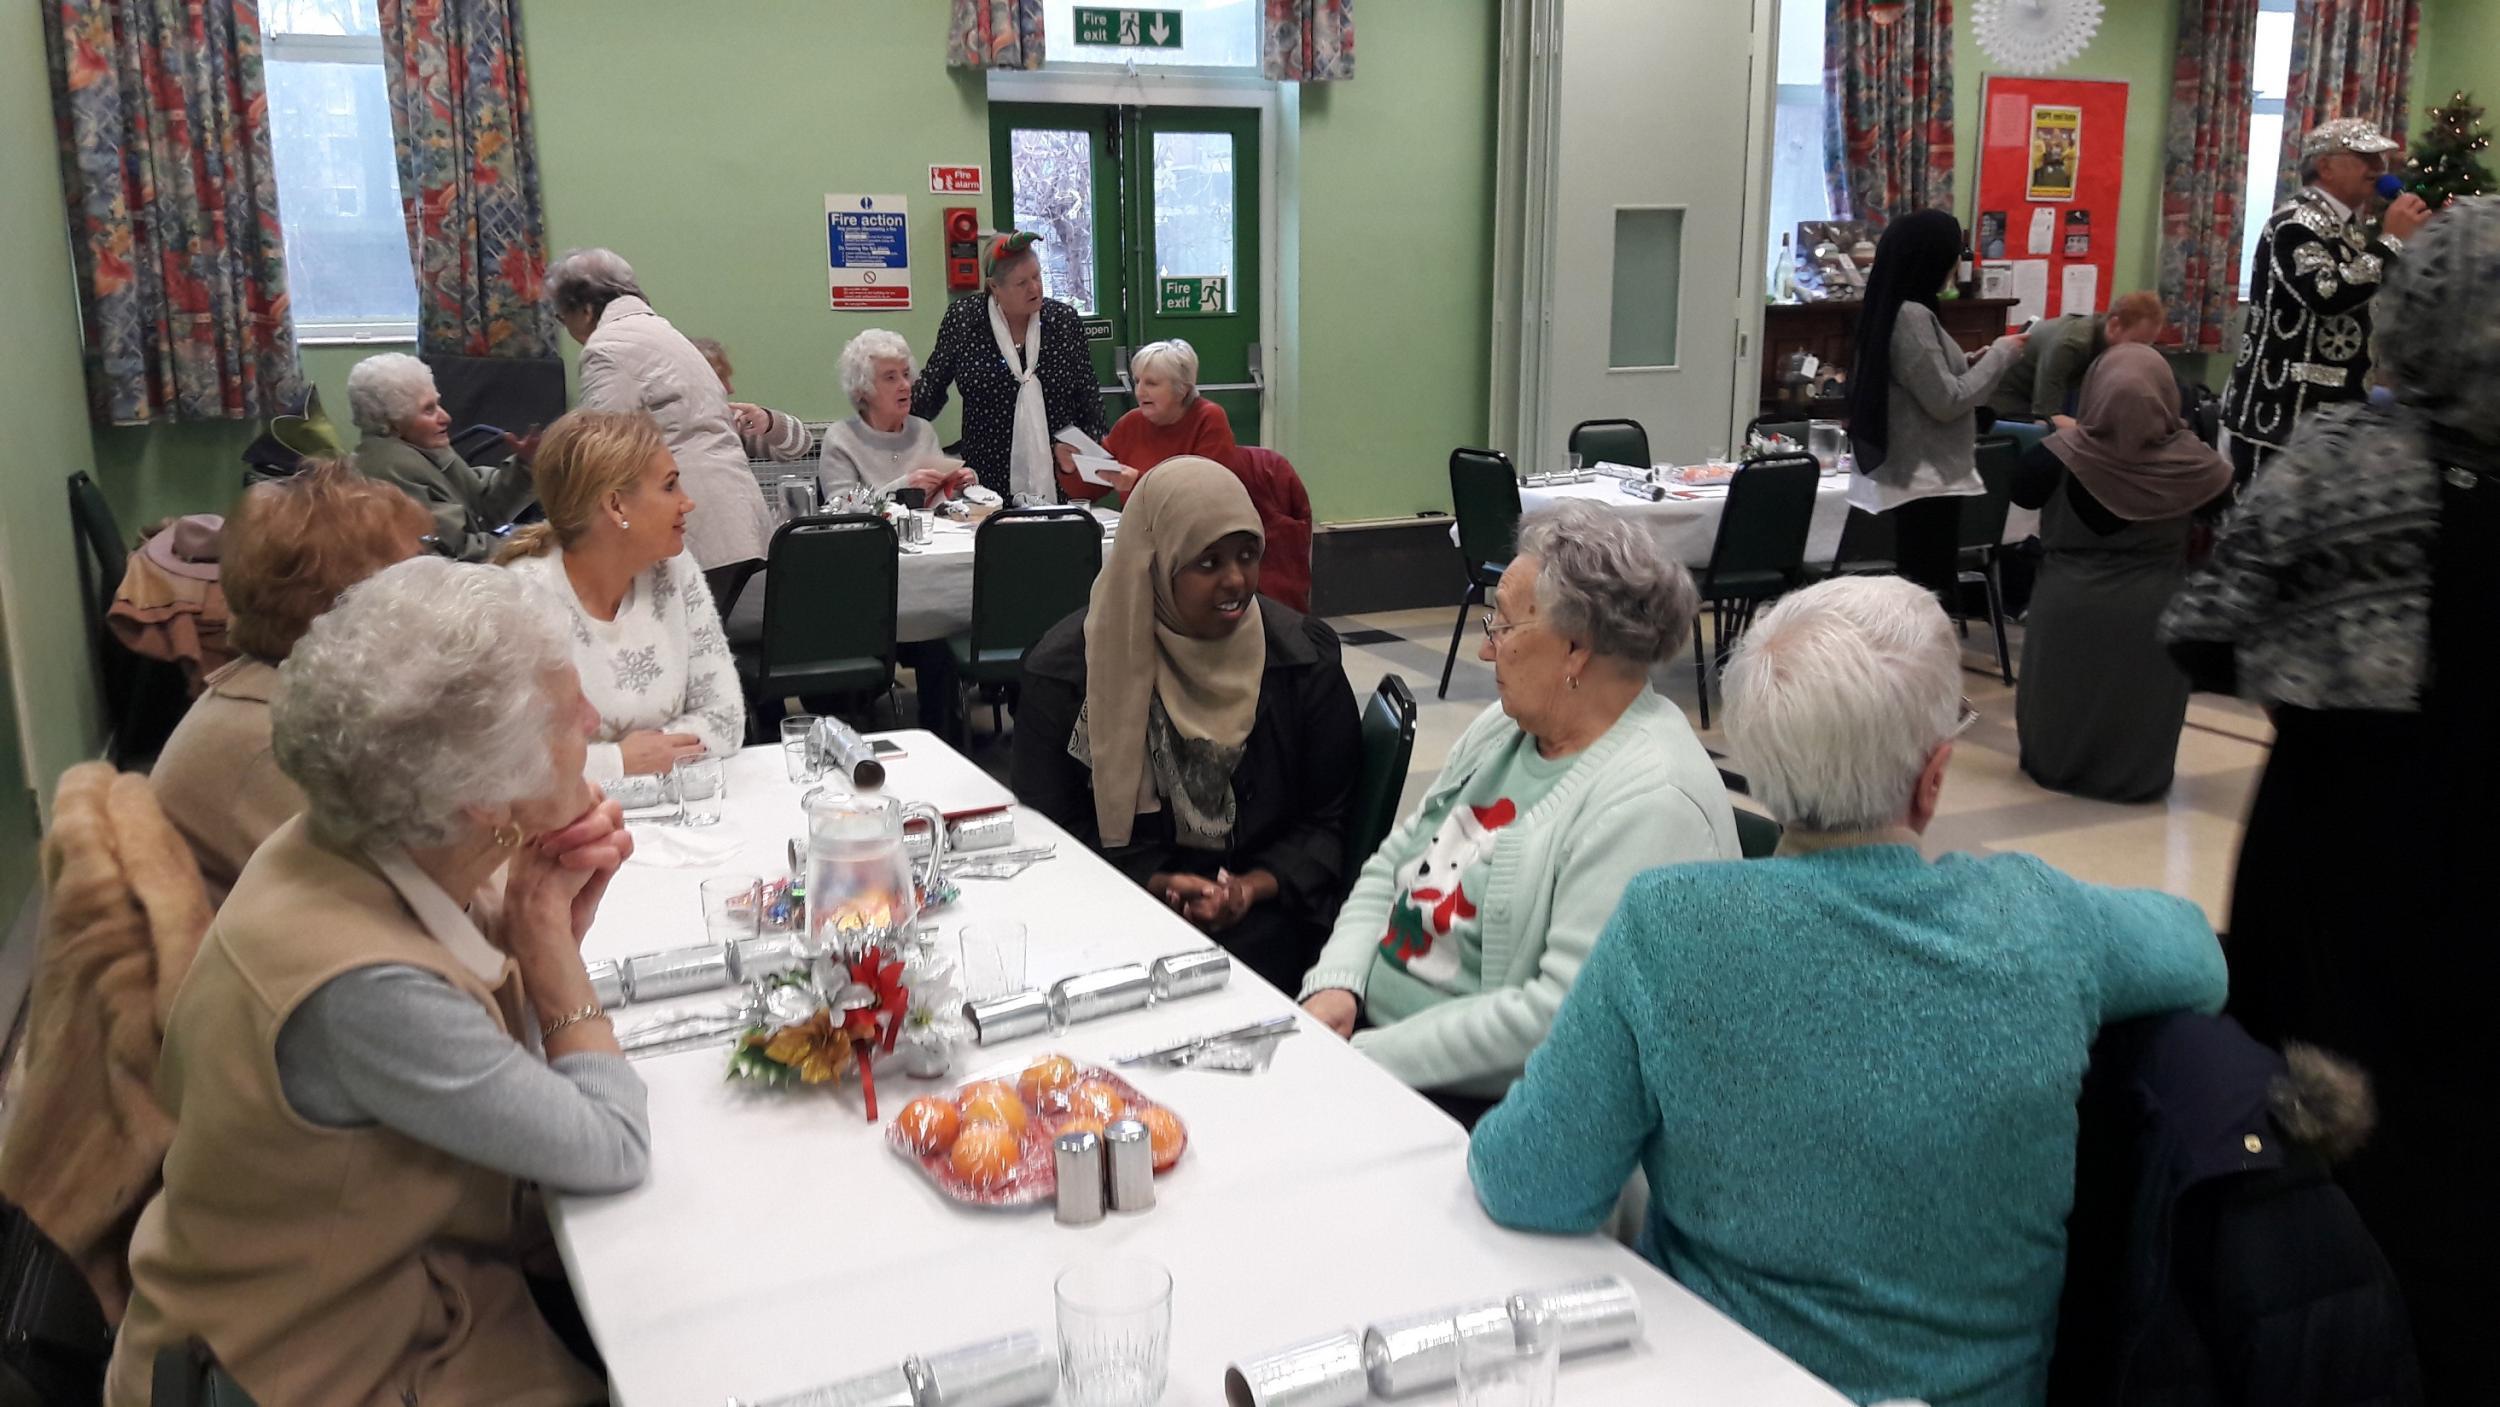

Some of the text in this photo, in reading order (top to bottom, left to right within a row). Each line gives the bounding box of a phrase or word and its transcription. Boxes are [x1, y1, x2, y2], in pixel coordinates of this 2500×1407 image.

[1083, 11, 1107, 25] Fire
[1083, 28, 1107, 41] exit
[954, 170, 972, 179] Fire
[954, 181, 979, 189] alarm
[831, 213, 903, 226] Fire action
[1166, 282, 1190, 294] Fire
[1166, 297, 1190, 308] exit
[1085, 325, 1109, 336] open
